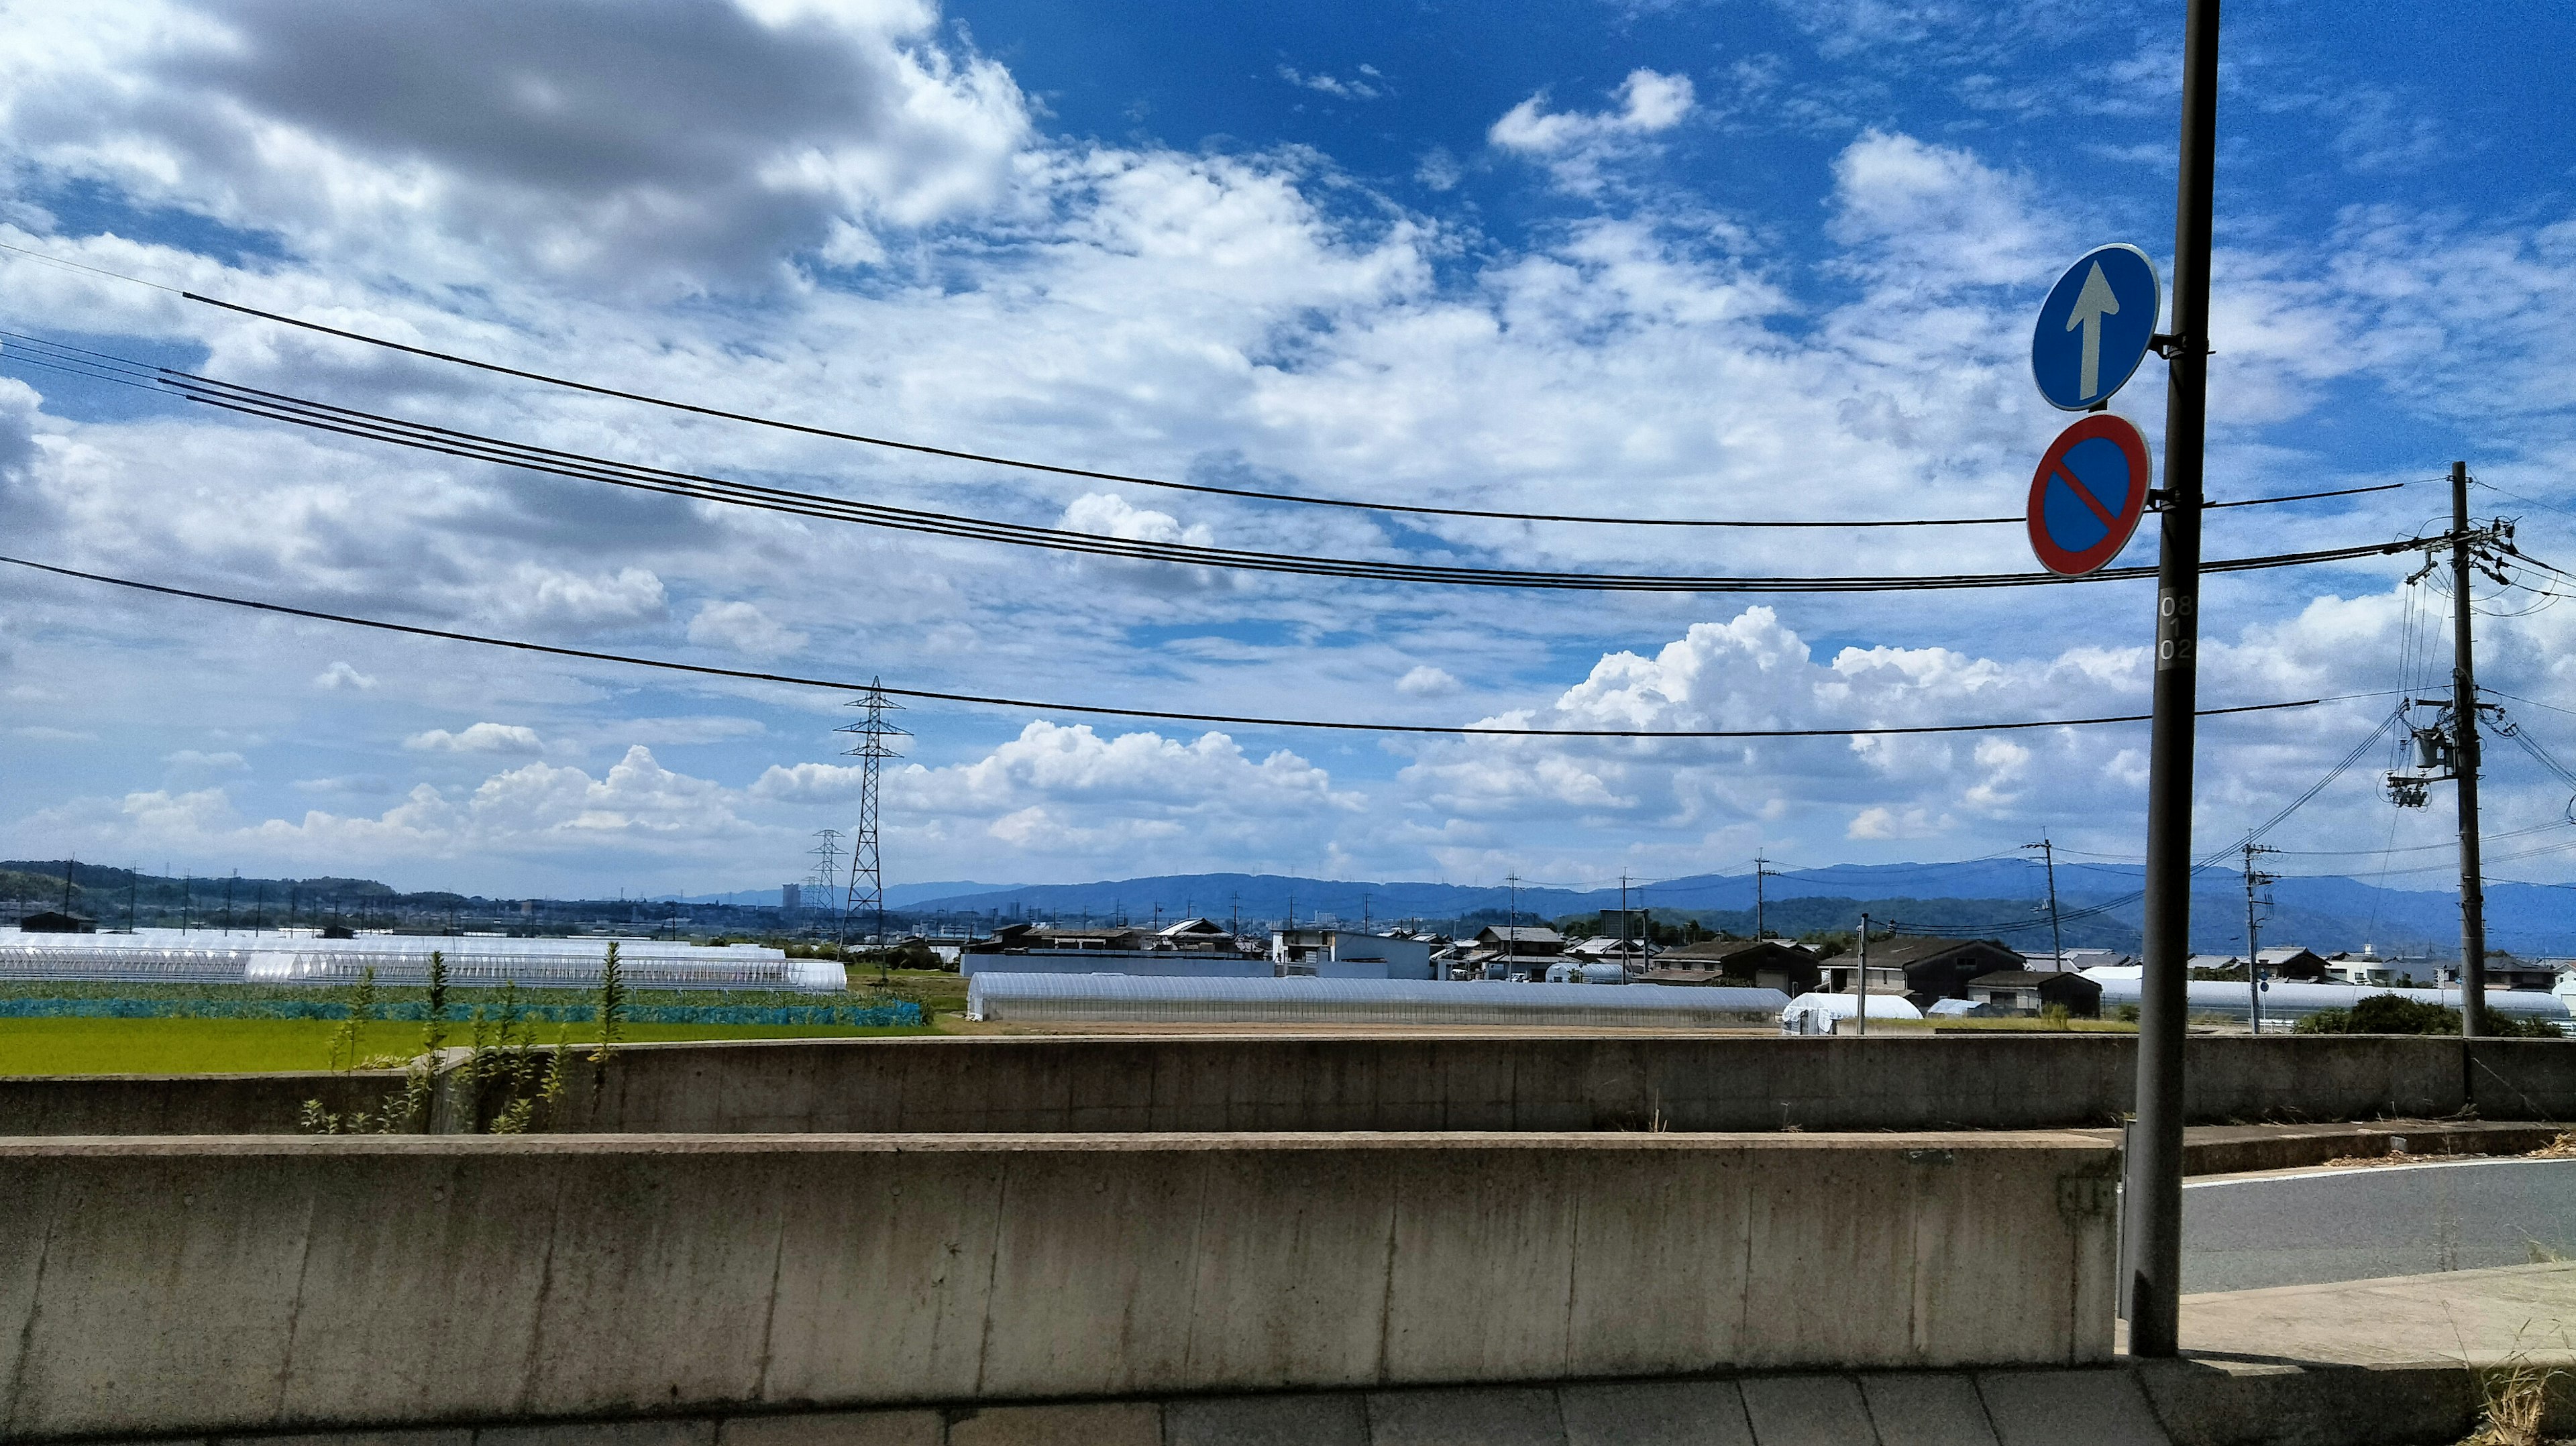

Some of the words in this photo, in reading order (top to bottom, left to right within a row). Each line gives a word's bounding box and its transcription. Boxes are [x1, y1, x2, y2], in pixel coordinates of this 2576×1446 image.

[2162, 596, 2192, 616] 08
[2170, 617, 2180, 637] 1
[2160, 639, 2191, 660] 02
